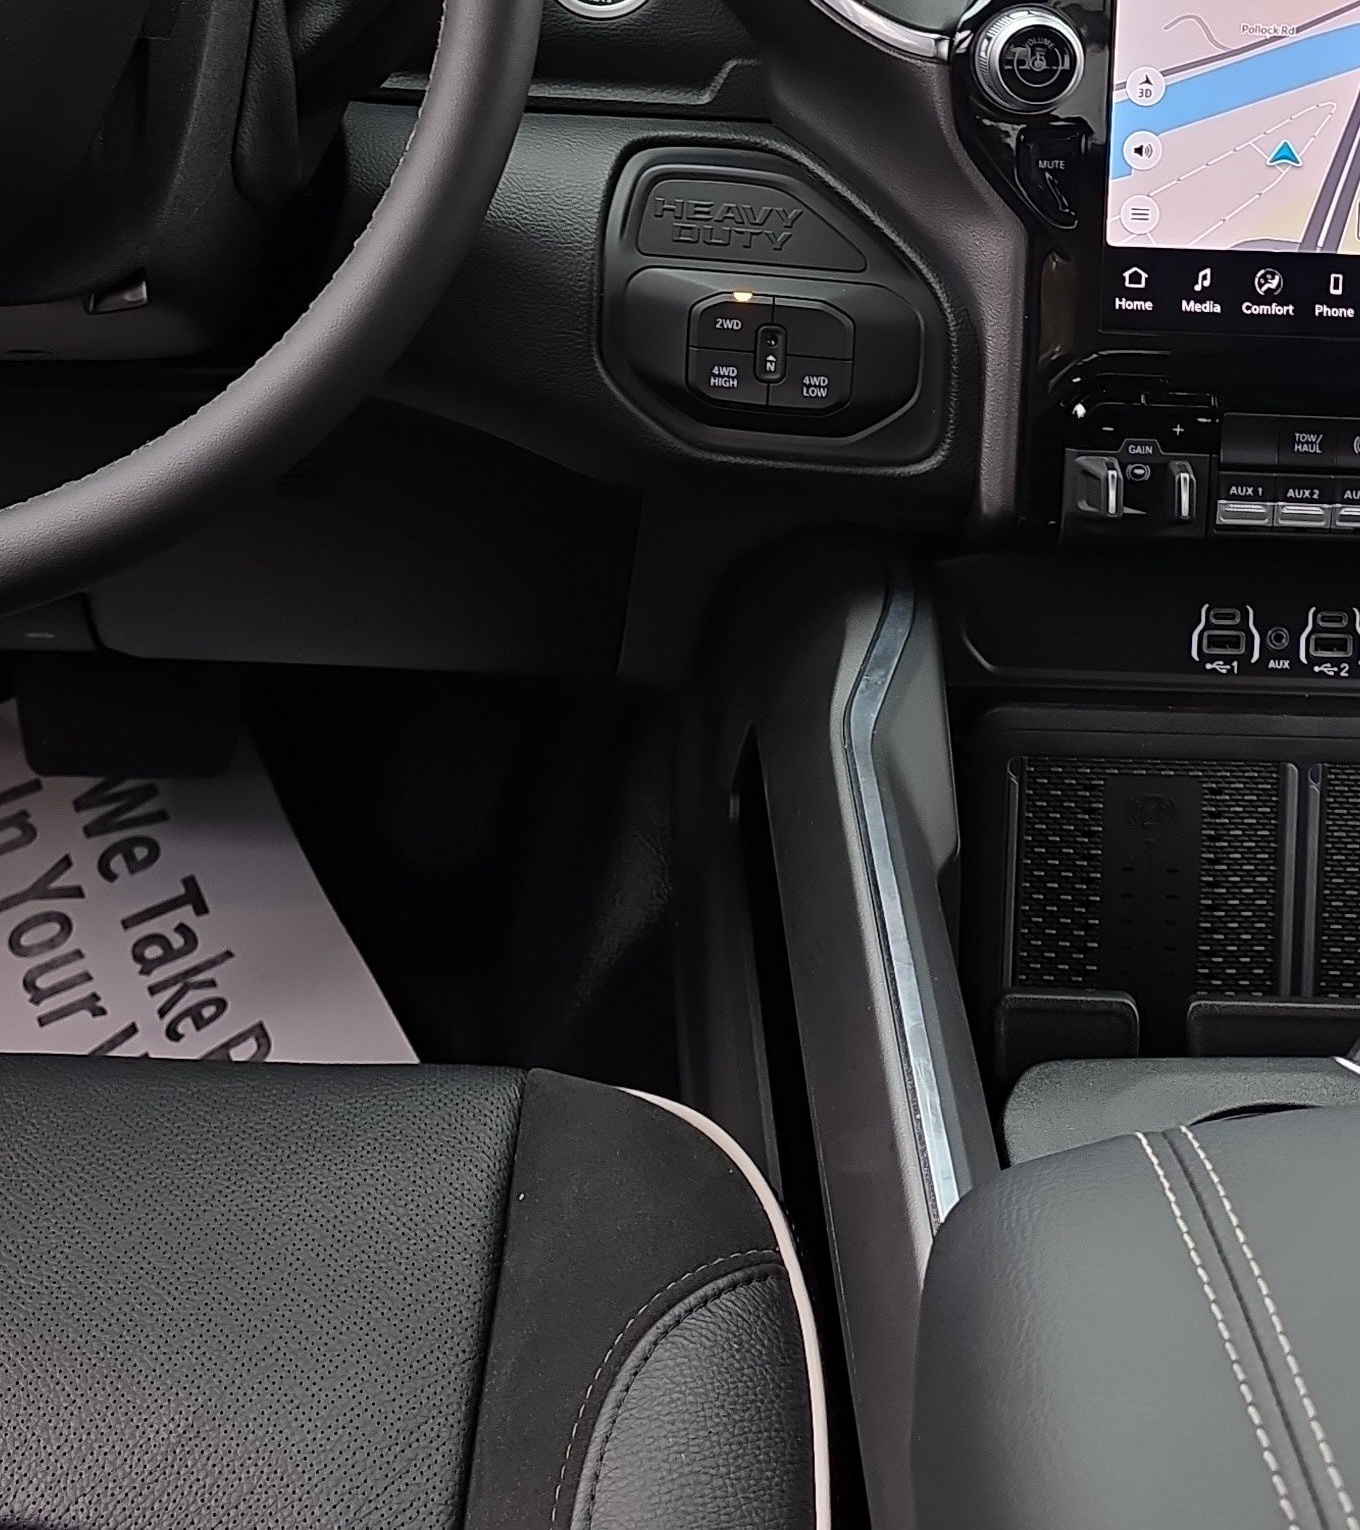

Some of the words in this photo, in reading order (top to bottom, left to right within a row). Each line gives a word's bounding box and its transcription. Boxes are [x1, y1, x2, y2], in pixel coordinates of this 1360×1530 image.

[1241, 24, 1274, 36] Pollock
[1276, 25, 1296, 36] Rd
[1137, 87, 1153, 99] 3D
[1038, 160, 1065, 169] MUTE
[653, 196, 804, 228] HEAVY
[671, 223, 793, 250] DUTY
[1115, 298, 1153, 311] Home
[1181, 301, 1221, 314] Media
[1242, 302, 1294, 316] Comfort
[1315, 304, 1354, 318] Phone
[715, 318, 742, 330] 2WD
[712, 365, 737, 377] 4WD
[766, 361, 776, 372] N
[710, 376, 738, 388] HIGH
[803, 375, 829, 387] 4WD
[803, 386, 828, 398] LOW
[1128, 444, 1153, 455] GAIN
[1294, 443, 1323, 454] HAUL
[1229, 486, 1254, 496] AUX
[1257, 487, 1263, 496] 1
[1287, 488, 1311, 498] AUX
[1312, 489, 1320, 499] 2
[1231, 660, 1238, 674] 1
[1268, 659, 1290, 669] AUX
[1340, 663, 1349, 677] 2
[73, 775, 170, 884] We
[120, 873, 235, 1043] Take
